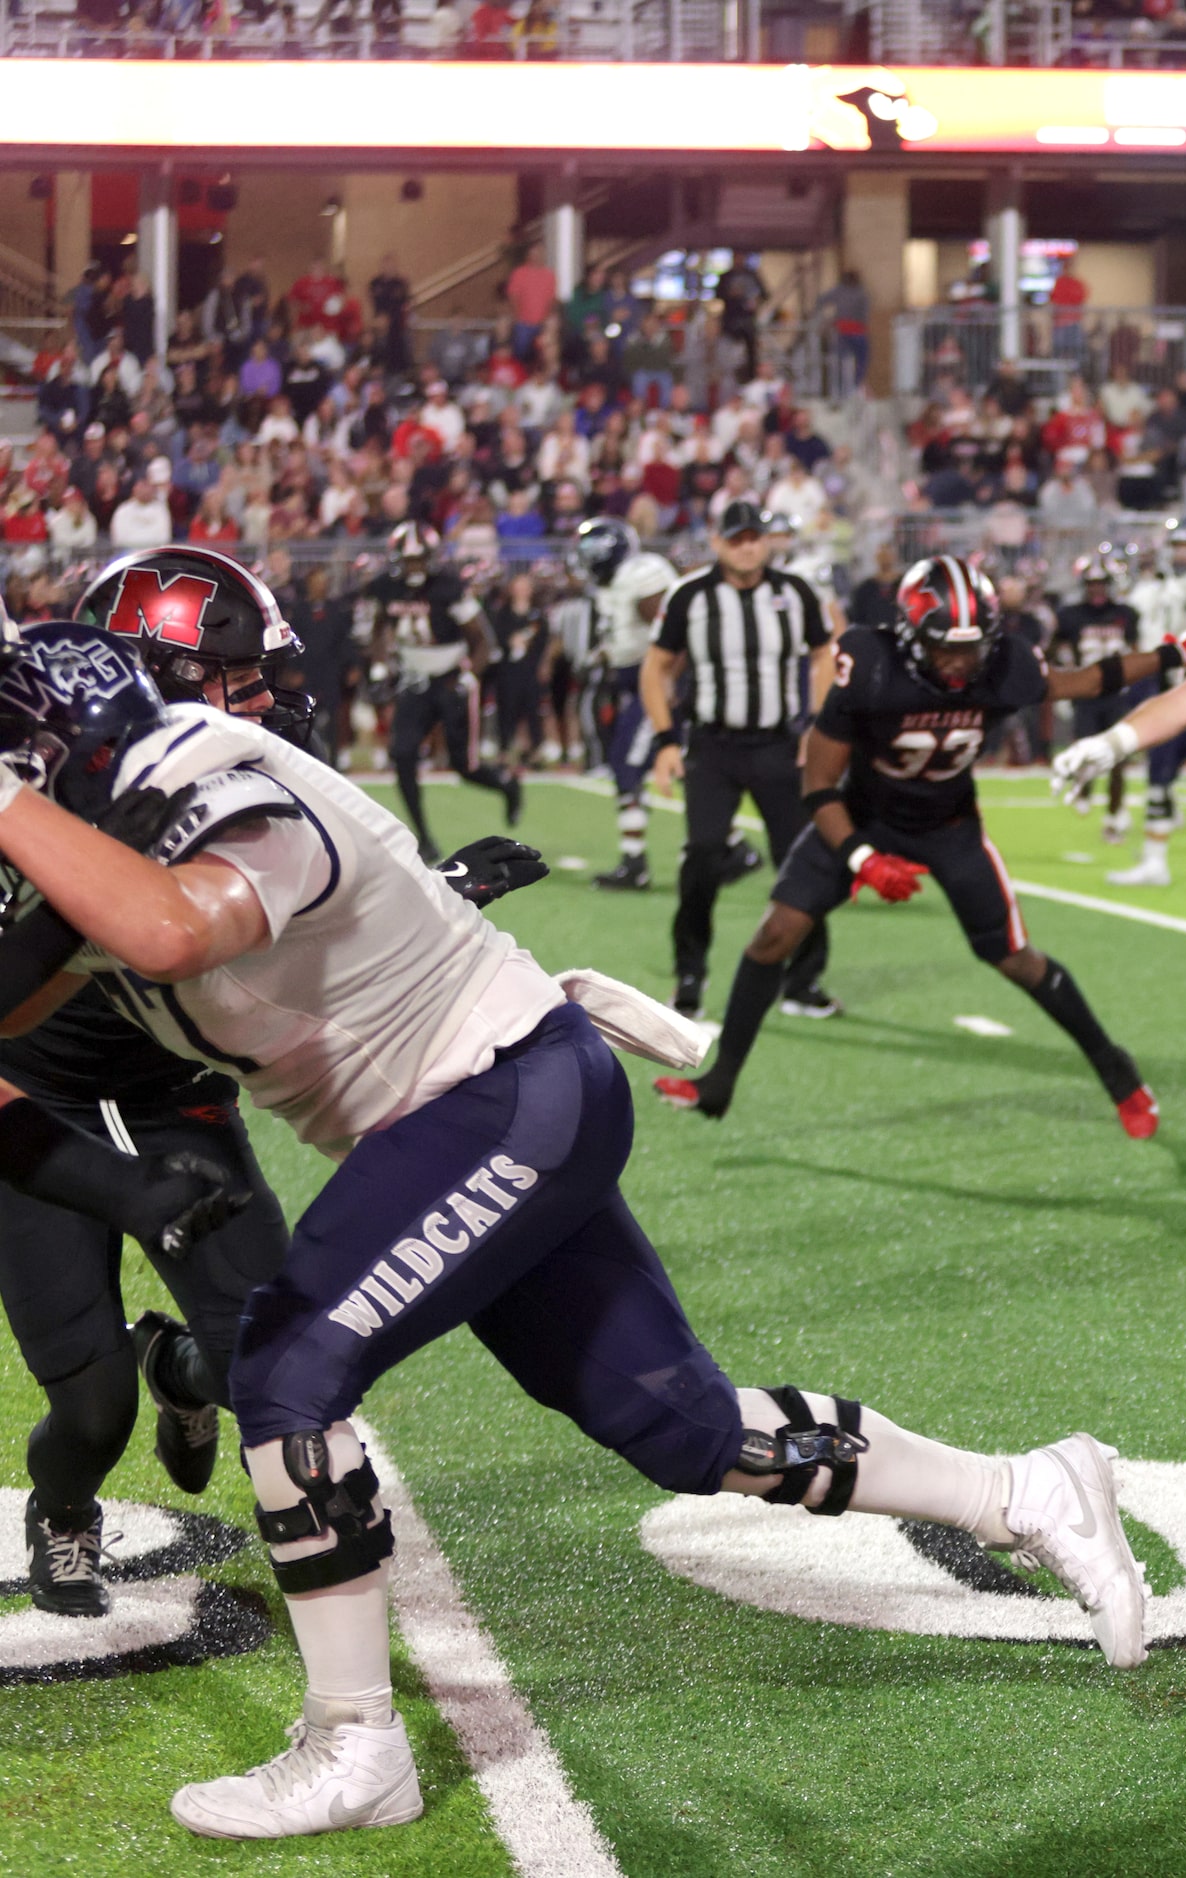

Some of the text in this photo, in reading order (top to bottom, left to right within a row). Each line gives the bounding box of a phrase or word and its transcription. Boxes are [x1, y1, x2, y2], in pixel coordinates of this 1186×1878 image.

[106, 567, 218, 650] M
[873, 729, 984, 782] 33
[328, 1155, 538, 1337] WILDCATS
